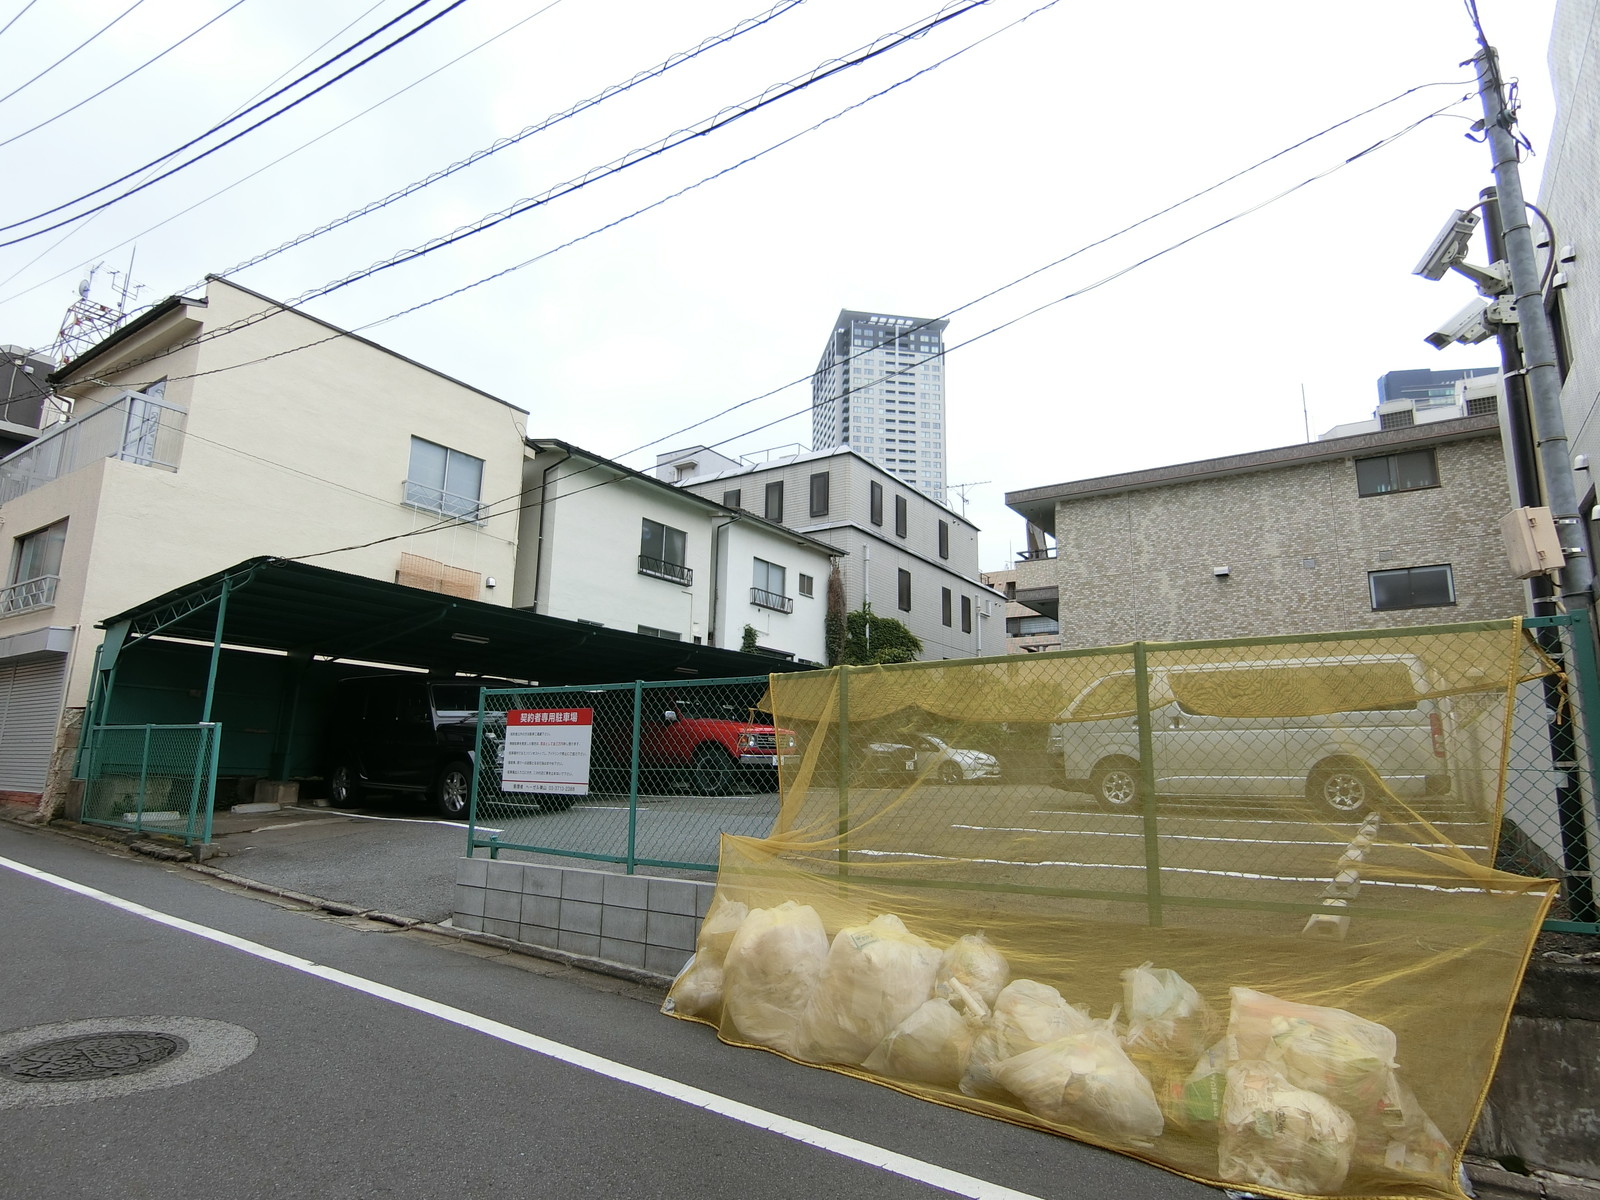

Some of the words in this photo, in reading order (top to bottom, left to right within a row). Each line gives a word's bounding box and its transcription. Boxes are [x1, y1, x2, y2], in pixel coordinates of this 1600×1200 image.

[520, 712, 578, 723] 契約者専用駐車場
